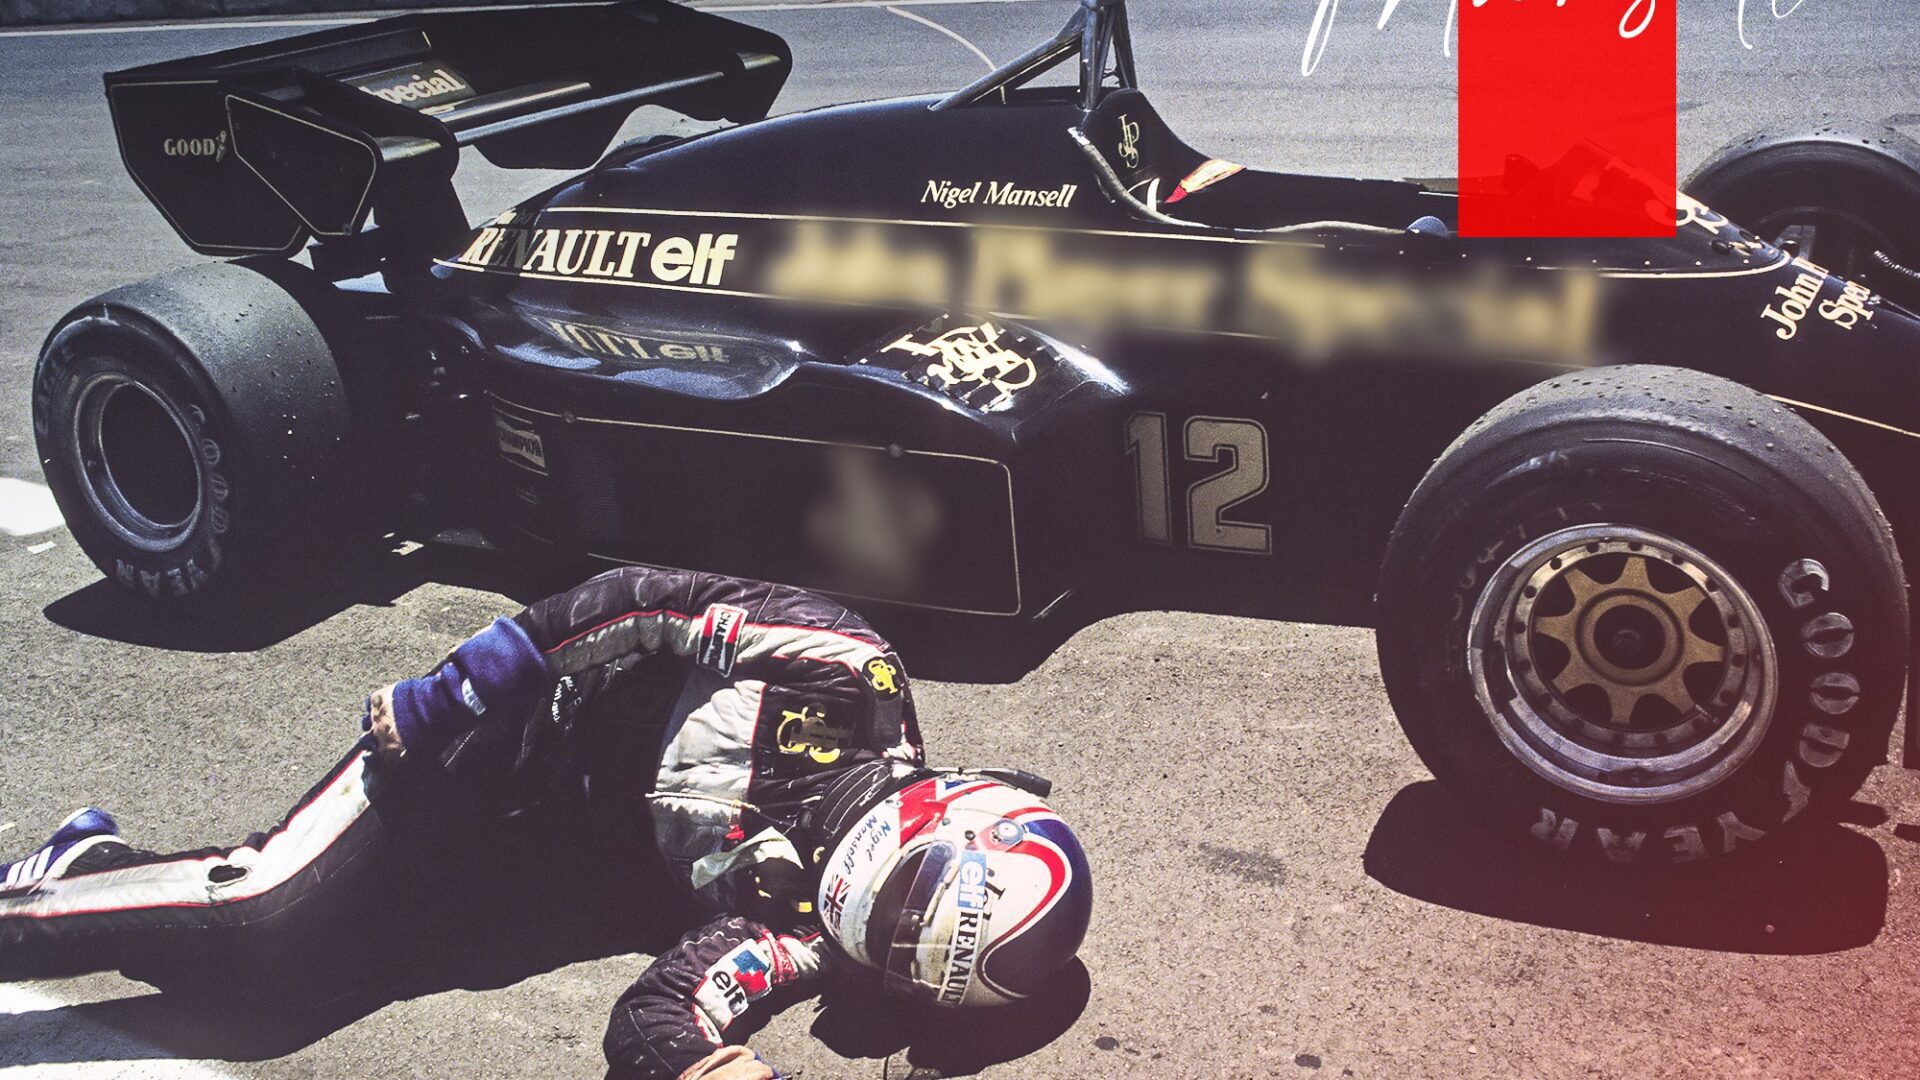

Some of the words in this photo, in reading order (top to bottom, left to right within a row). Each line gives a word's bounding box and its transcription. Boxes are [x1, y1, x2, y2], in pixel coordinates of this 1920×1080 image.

[358, 68, 466, 105] pecial
[920, 179, 982, 209] Nigel
[982, 180, 1078, 208] Mansell
[457, 226, 651, 278] RENAULT
[650, 233, 739, 286] elf
[1760, 272, 1824, 341] John
[1124, 410, 1272, 556] 12
